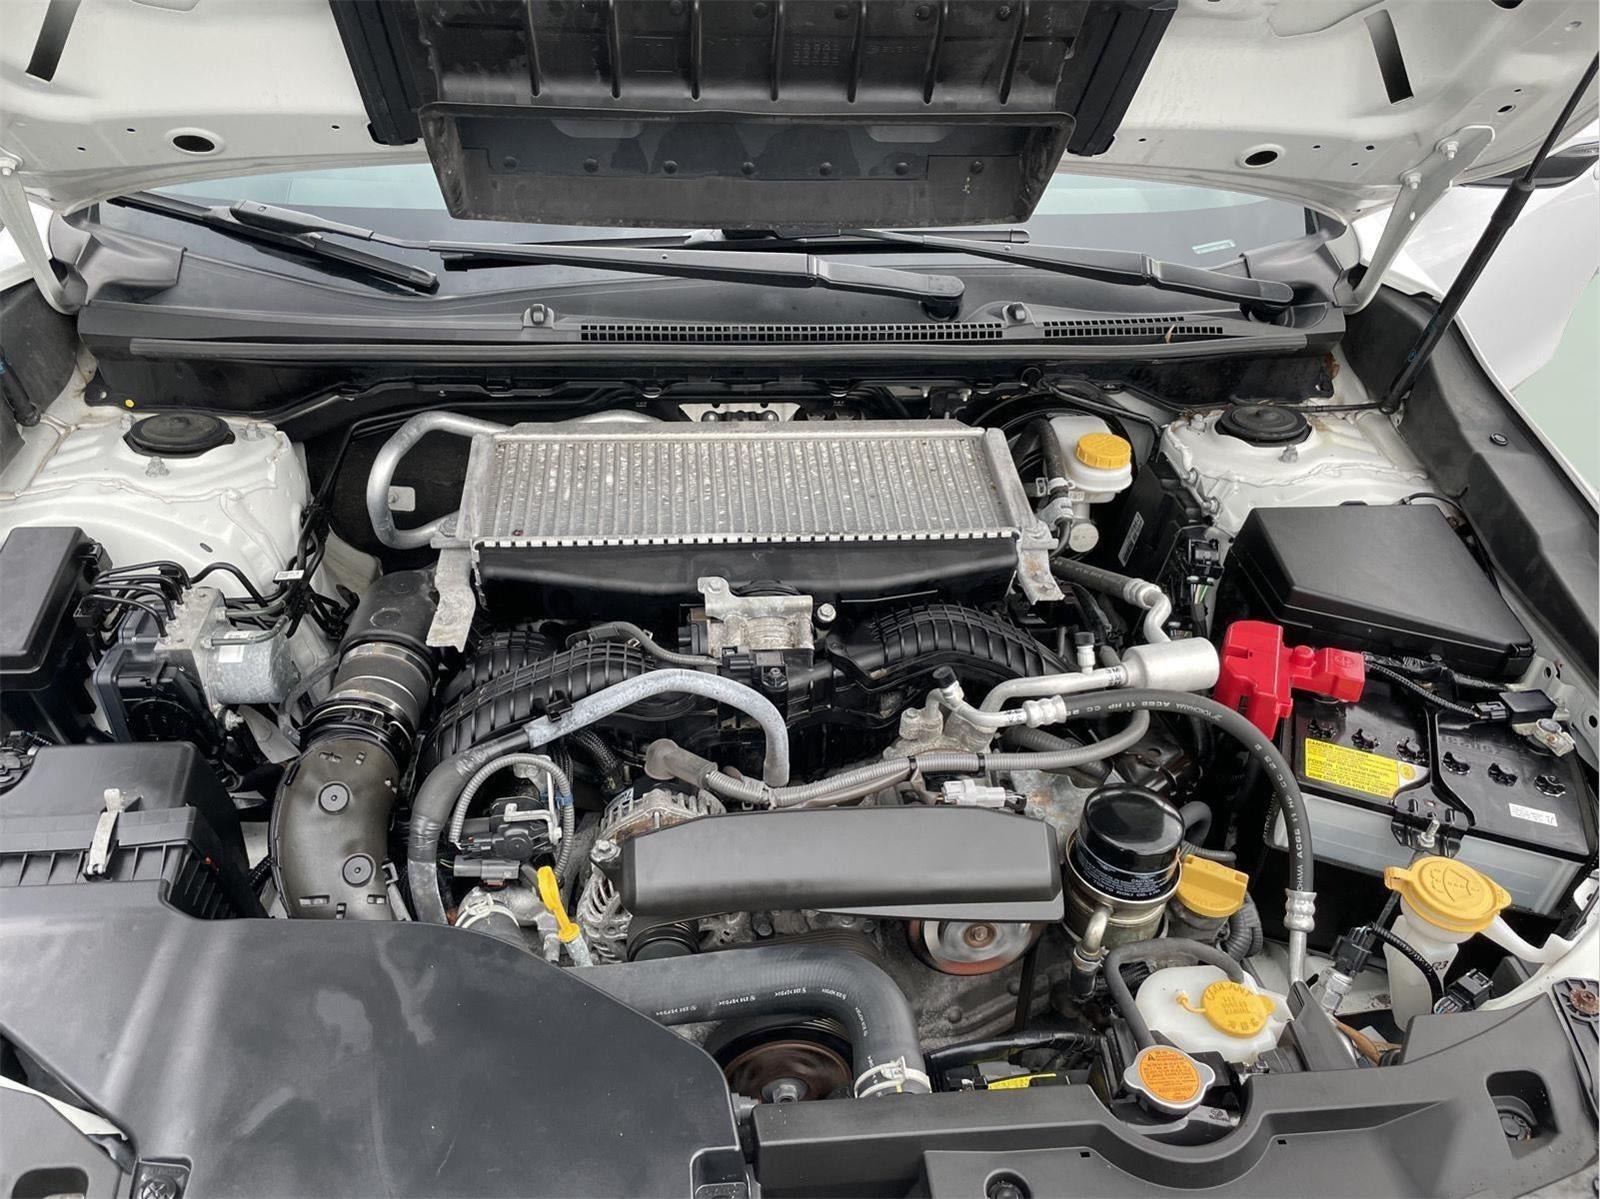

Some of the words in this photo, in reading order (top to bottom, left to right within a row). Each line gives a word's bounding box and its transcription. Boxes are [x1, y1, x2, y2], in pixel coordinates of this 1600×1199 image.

[1108, 702, 1122, 710] HP
[1176, 702, 1213, 717] YOKOHAMA
[1285, 794, 1295, 808] HP
[1292, 812, 1299, 822] 11
